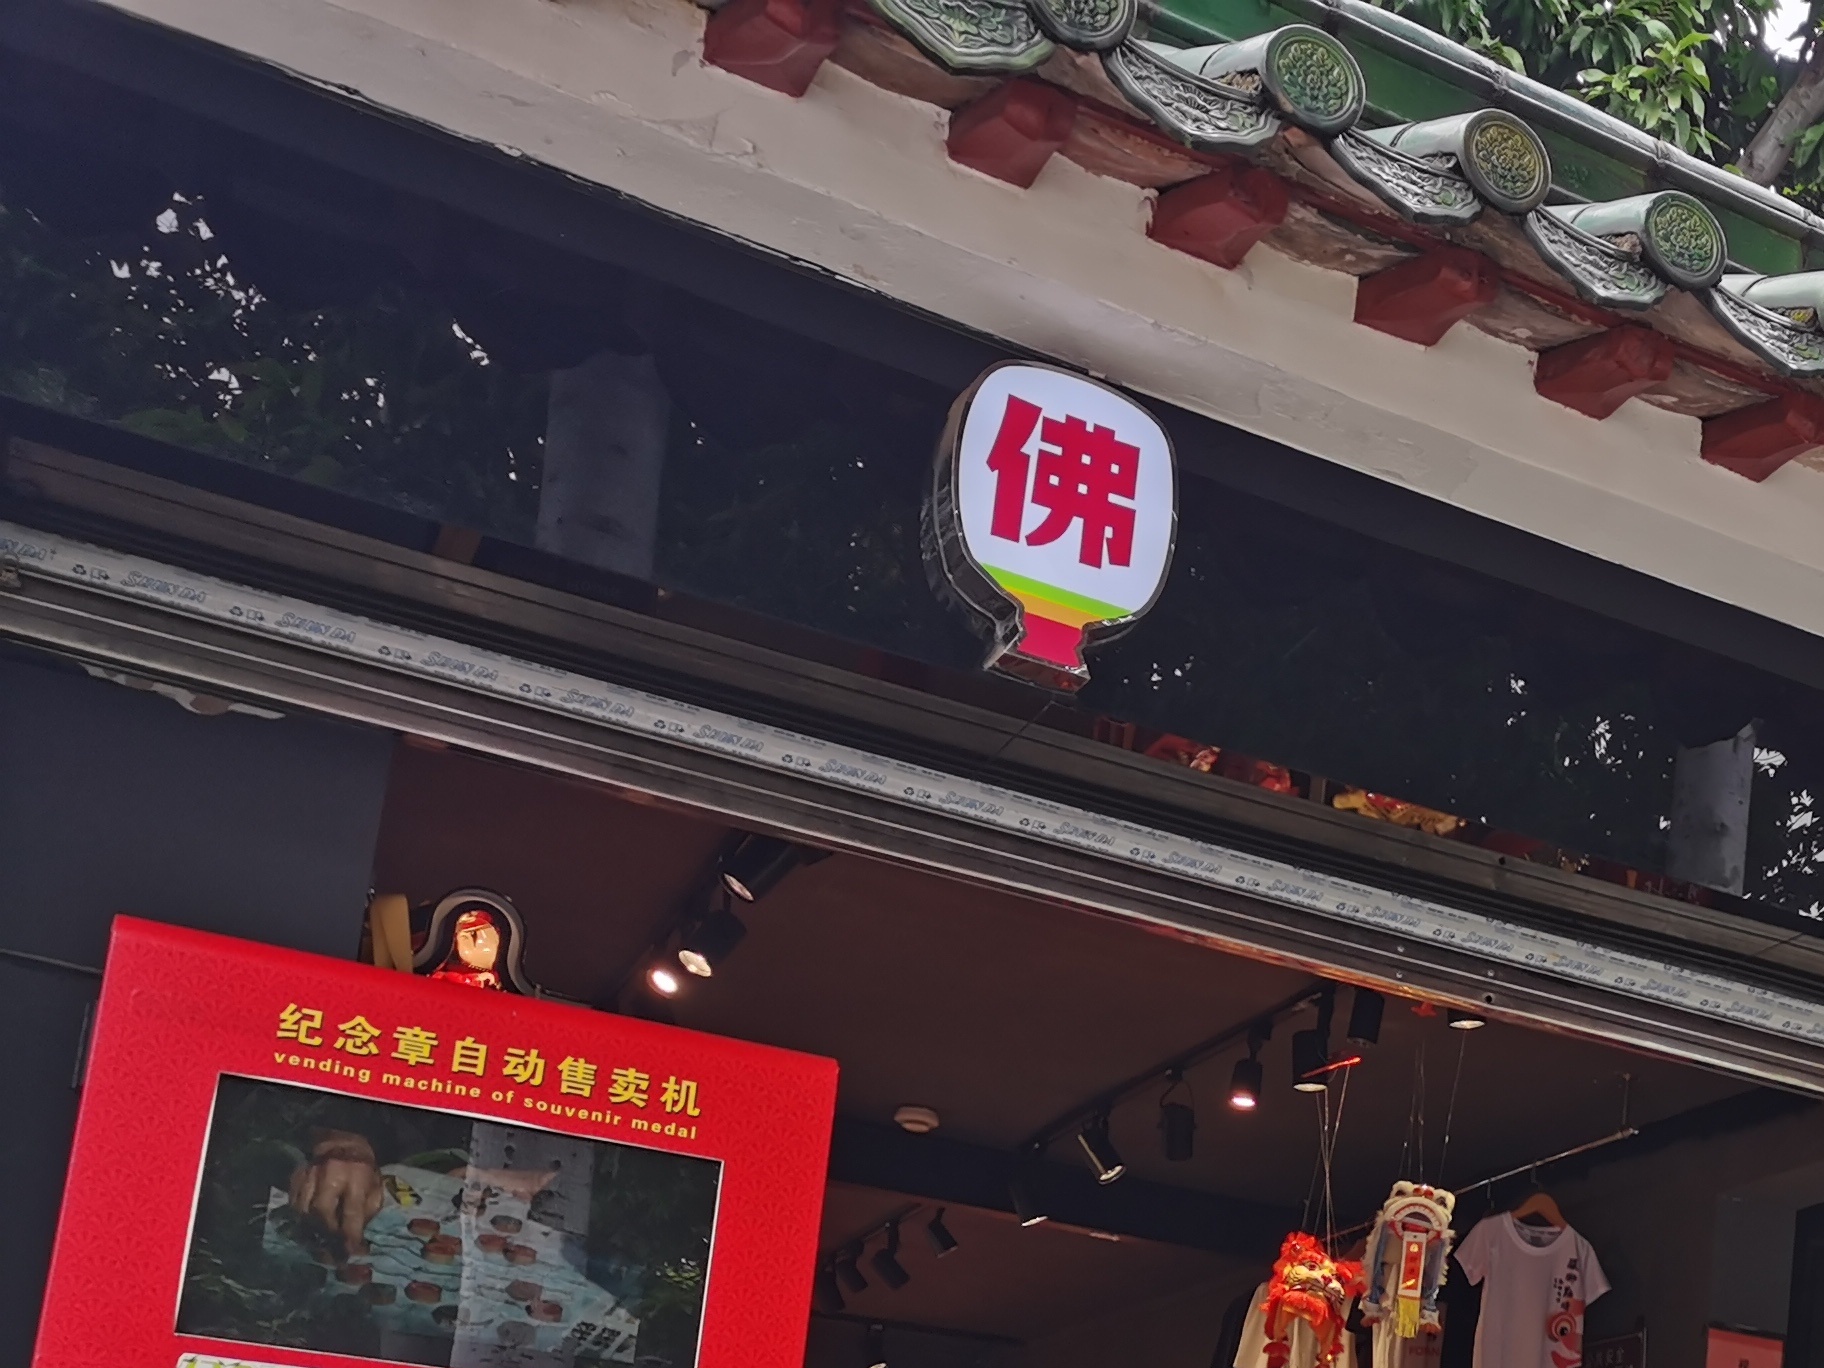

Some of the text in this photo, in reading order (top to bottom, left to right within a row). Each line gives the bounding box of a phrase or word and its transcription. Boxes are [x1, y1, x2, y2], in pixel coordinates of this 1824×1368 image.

[986, 393, 1141, 570] 佛
[274, 1052, 698, 1140] vending machine of souvenir medal
[276, 1002, 701, 1118] 纪念章自动售卖机
